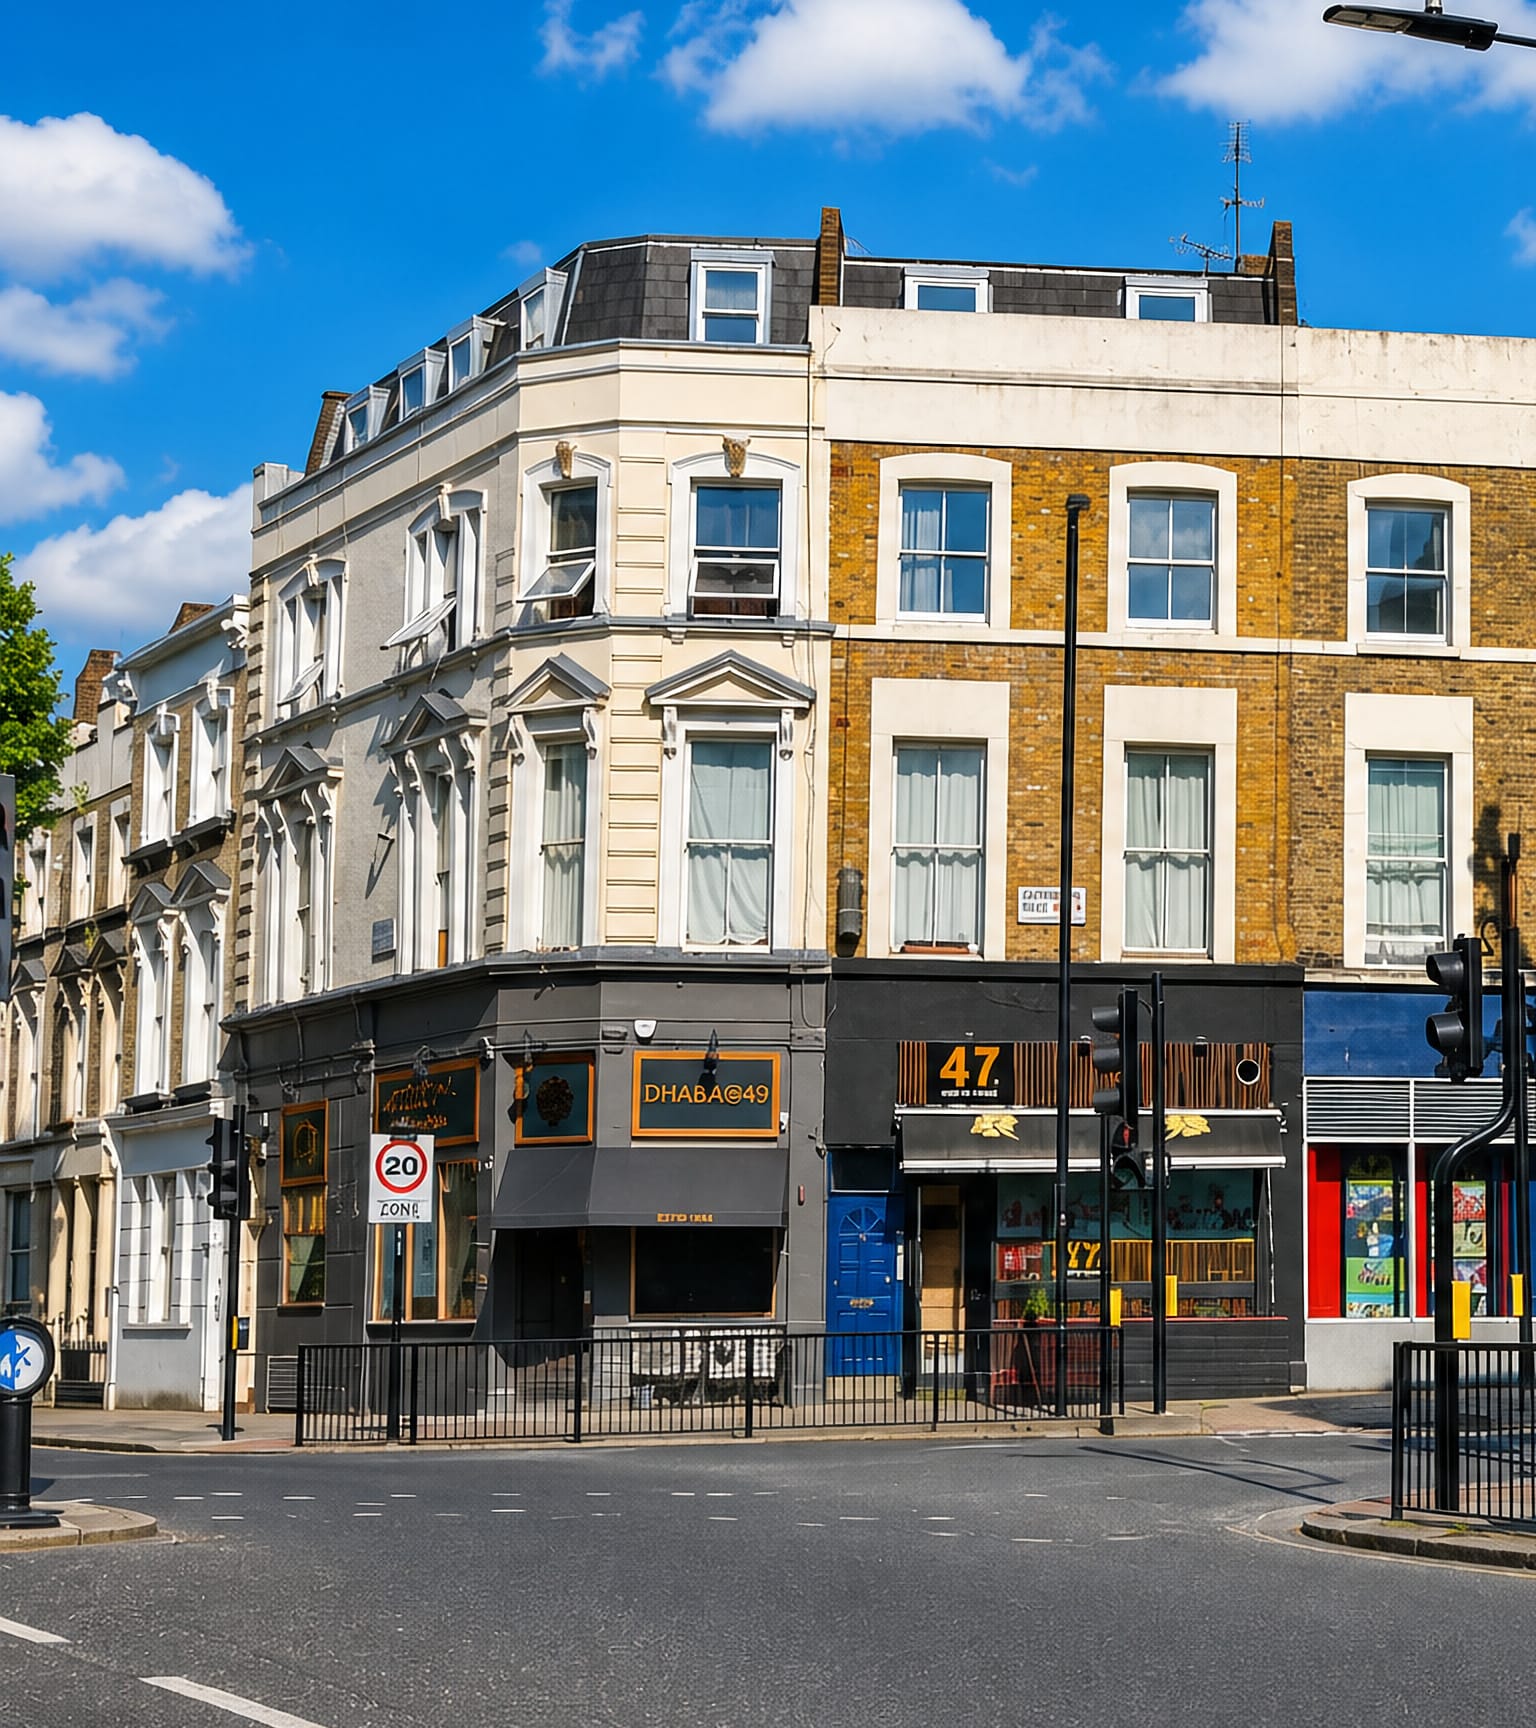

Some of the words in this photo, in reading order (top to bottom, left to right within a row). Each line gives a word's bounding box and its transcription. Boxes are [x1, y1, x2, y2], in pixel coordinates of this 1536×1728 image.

[939, 1046, 1000, 1088] 47
[644, 1084, 769, 1105] DHABA@49
[385, 1156, 418, 1176] 20
